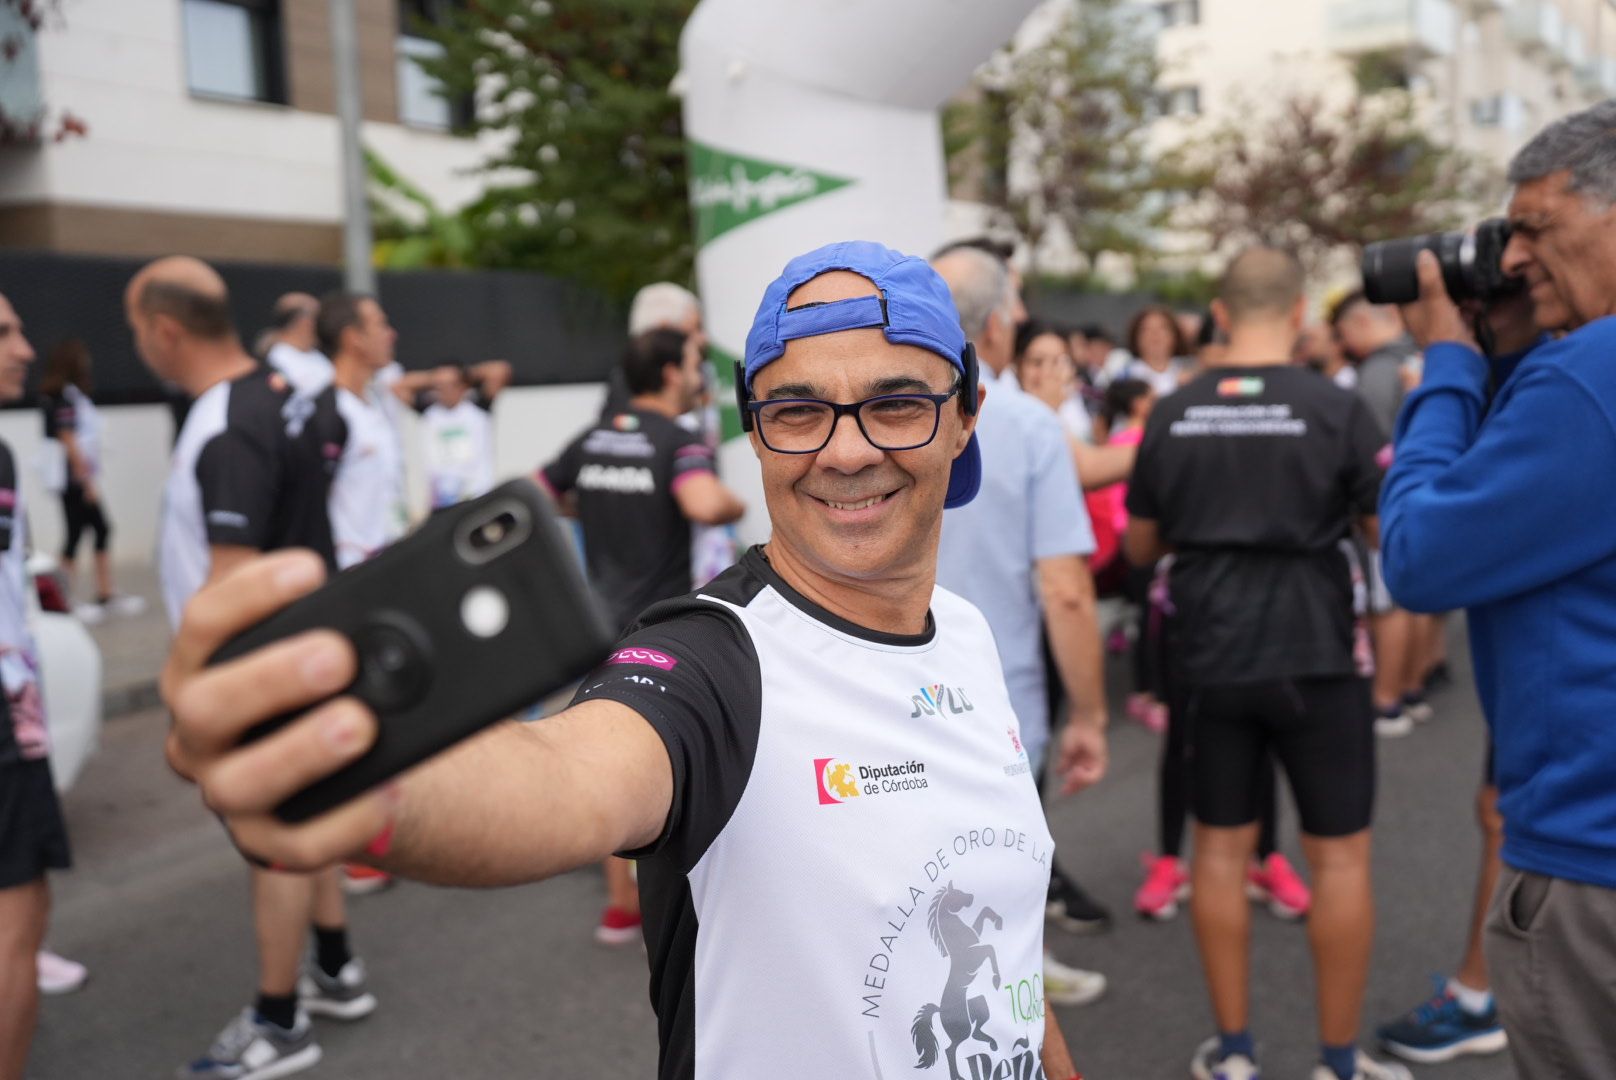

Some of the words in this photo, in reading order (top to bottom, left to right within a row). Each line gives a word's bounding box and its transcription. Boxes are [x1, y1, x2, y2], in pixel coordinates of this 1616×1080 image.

[859, 760, 925, 781] Diputación
[864, 782, 880, 795] de
[881, 776, 929, 793] Córdoba
[861, 886, 925, 1018] MEDALLA
[924, 848, 950, 882] DE
[953, 827, 995, 855] ORO
[1004, 828, 1026, 852] DE
[1031, 839, 1046, 872] LA
